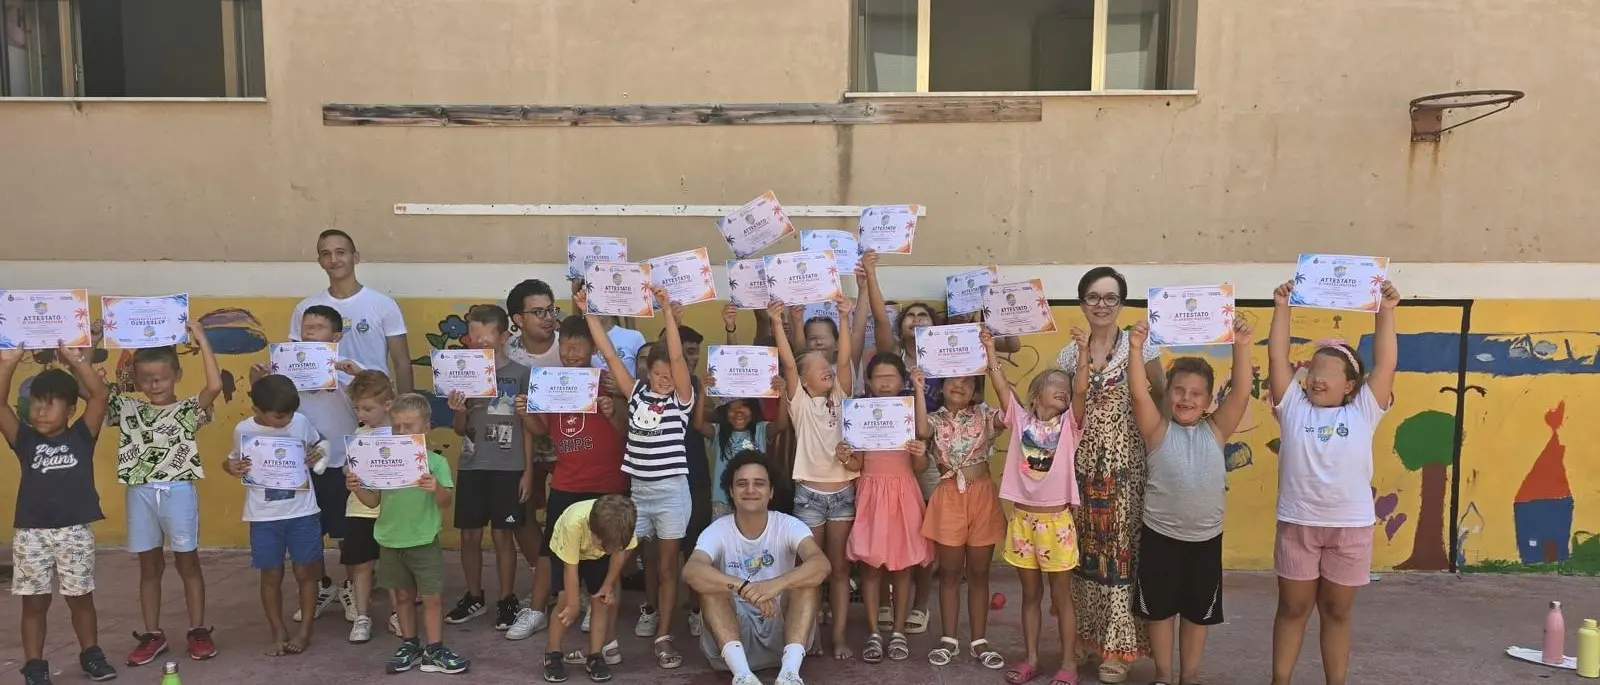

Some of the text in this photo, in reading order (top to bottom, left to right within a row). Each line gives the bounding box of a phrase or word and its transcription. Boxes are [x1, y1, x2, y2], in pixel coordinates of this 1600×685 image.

[789, 273, 818, 281] ATTESTATO
[1001, 305, 1028, 313] ATTESTATO
[35, 443, 70, 457] Pepe
[31, 453, 78, 471] Jeans
